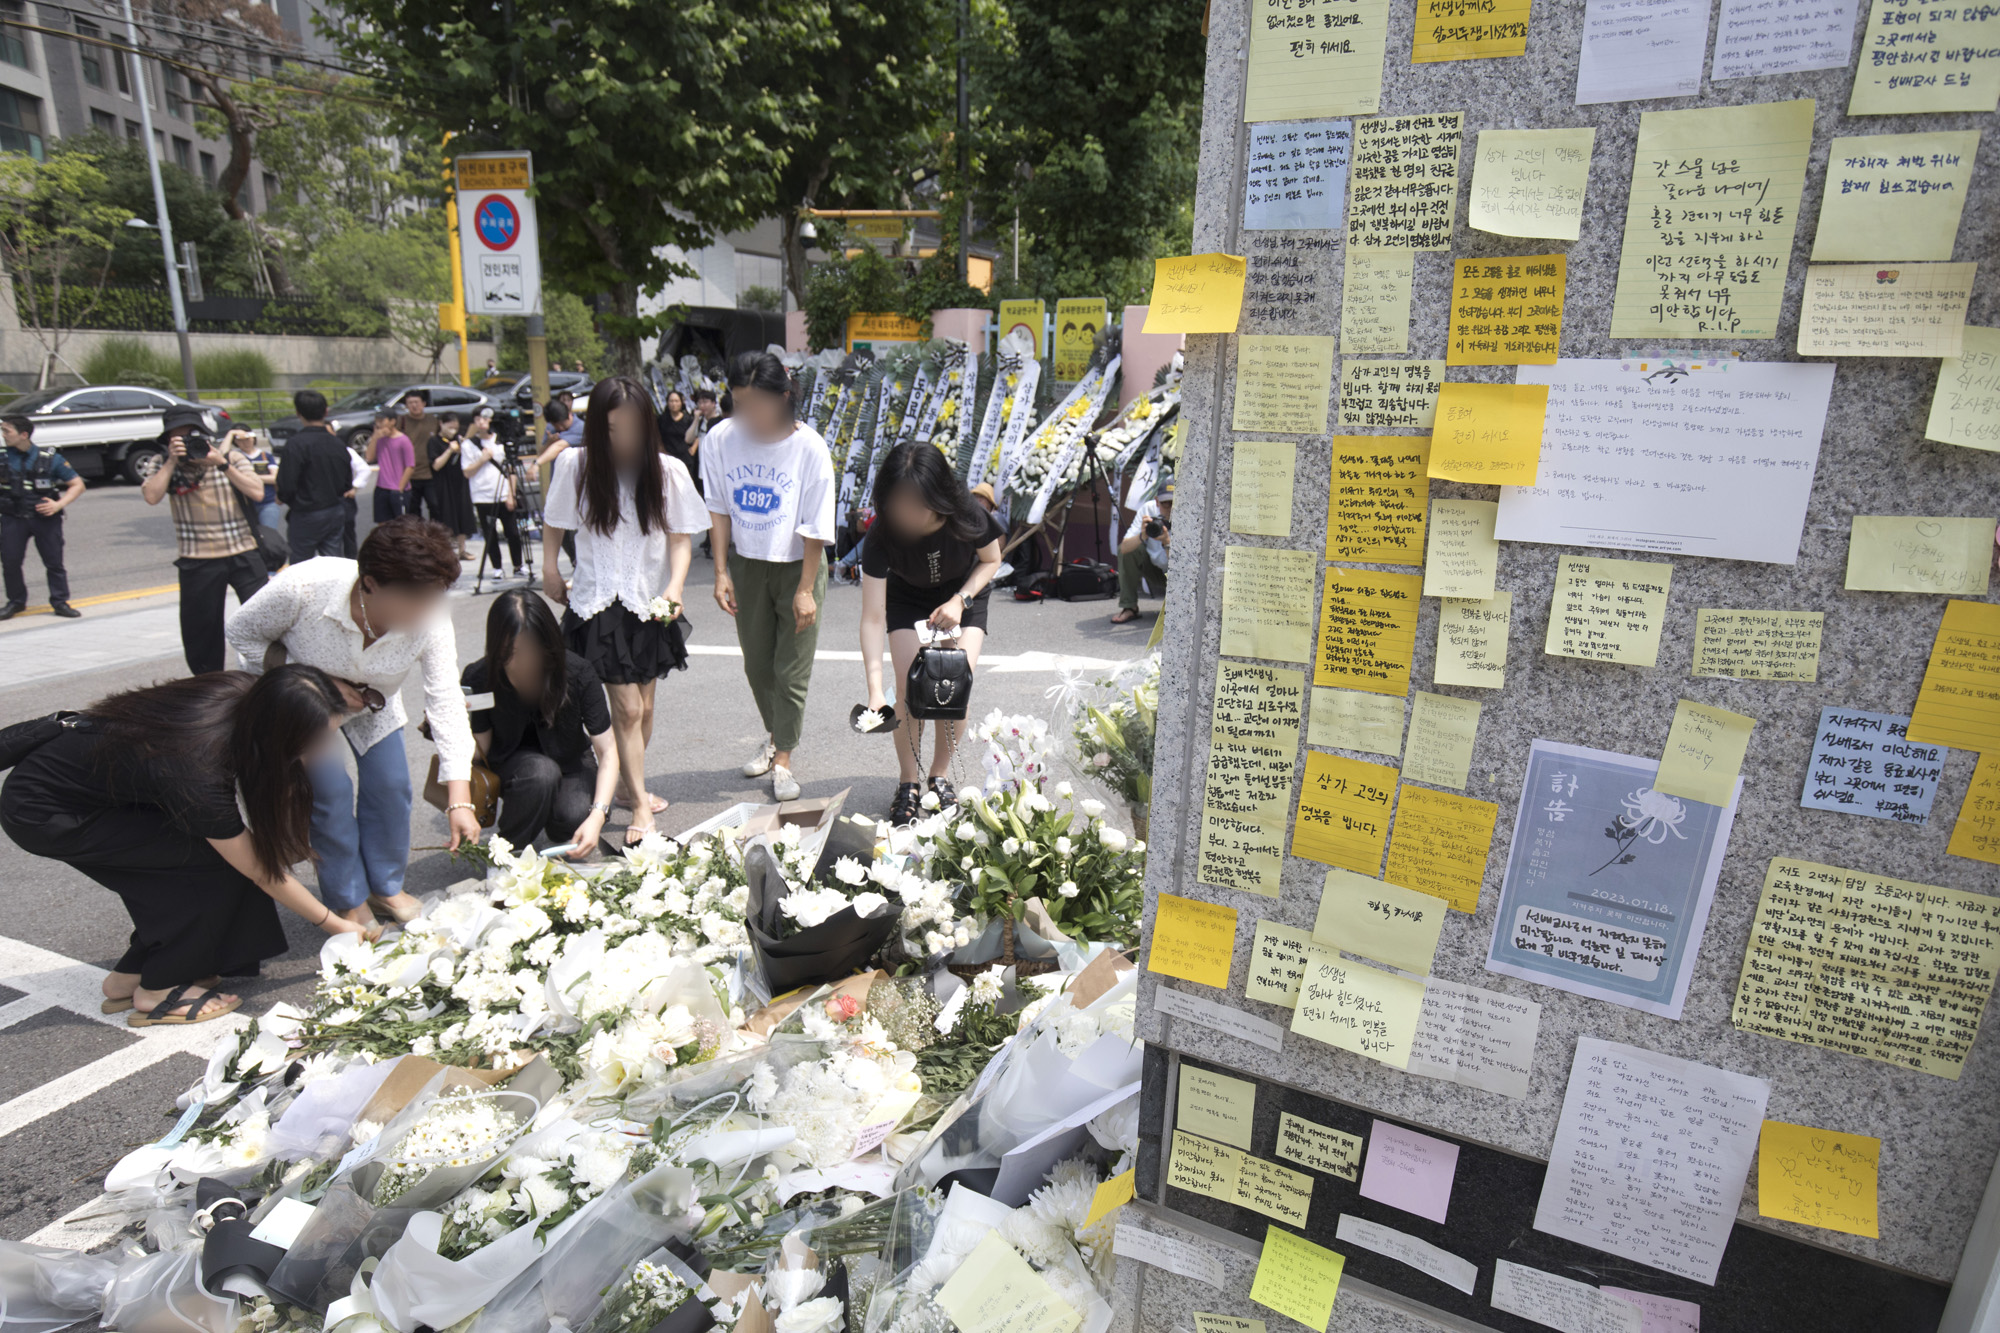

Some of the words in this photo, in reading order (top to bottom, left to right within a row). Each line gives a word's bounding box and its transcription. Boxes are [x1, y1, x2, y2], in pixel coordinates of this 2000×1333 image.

[1289, 39, 1315, 58] 편히
[1320, 39, 1356, 54] 쉬세요.
[1729, 208, 1752, 225] 너무
[484, 262, 520, 277] 견인지역
[1646, 255, 1672, 272] 이런
[1708, 288, 1731, 306] 너무
[1351, 365, 1371, 379] 삼가
[1372, 366, 1400, 379] 고인의
[1404, 366, 1432, 380] 명복을
[726, 463, 796, 494] VINTAGE
[741, 488, 773, 509] 1987
[1266, 685, 1300, 698] 얼마나
[1317, 772, 1348, 795] 삼가
[1353, 783, 1389, 806] 고인의
[1301, 804, 1333, 827] 명복을
[1342, 814, 1378, 839] 빕니다.
[1779, 865, 1800, 878] 저도
[1808, 871, 1841, 886] 2년차
[1845, 876, 1867, 892] 담임
[1772, 879, 1834, 903] 교육환경에서
[1870, 902, 1912, 921] 아이들이
[1318, 963, 1346, 984] 선생님
[1302, 1006, 1326, 1022] 편히
[1360, 1037, 1396, 1053] 빕니다
